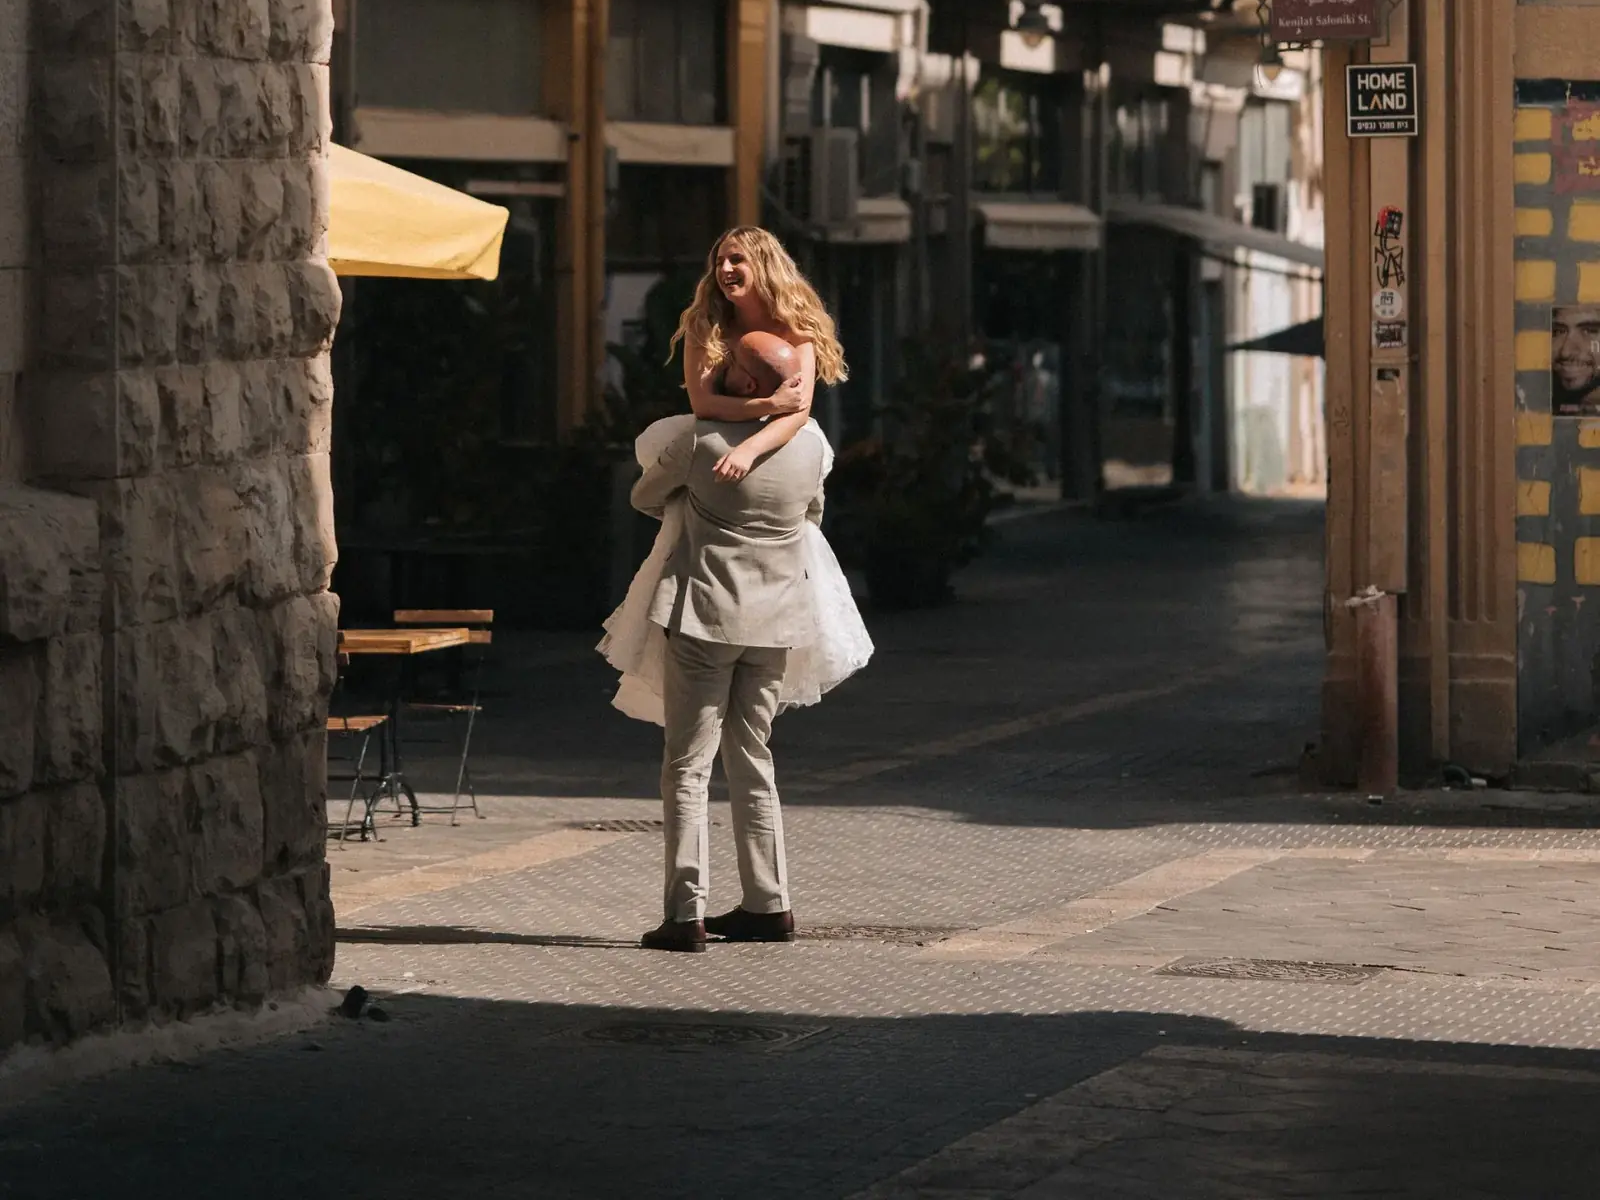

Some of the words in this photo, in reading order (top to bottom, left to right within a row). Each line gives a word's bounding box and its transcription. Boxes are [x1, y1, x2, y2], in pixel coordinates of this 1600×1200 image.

[1316, 14, 1355, 26] Saloniki
[1358, 14, 1371, 25] St.
[1357, 72, 1407, 90] HOME
[1357, 93, 1407, 111] LAND
[1397, 121, 1408, 129] בית
